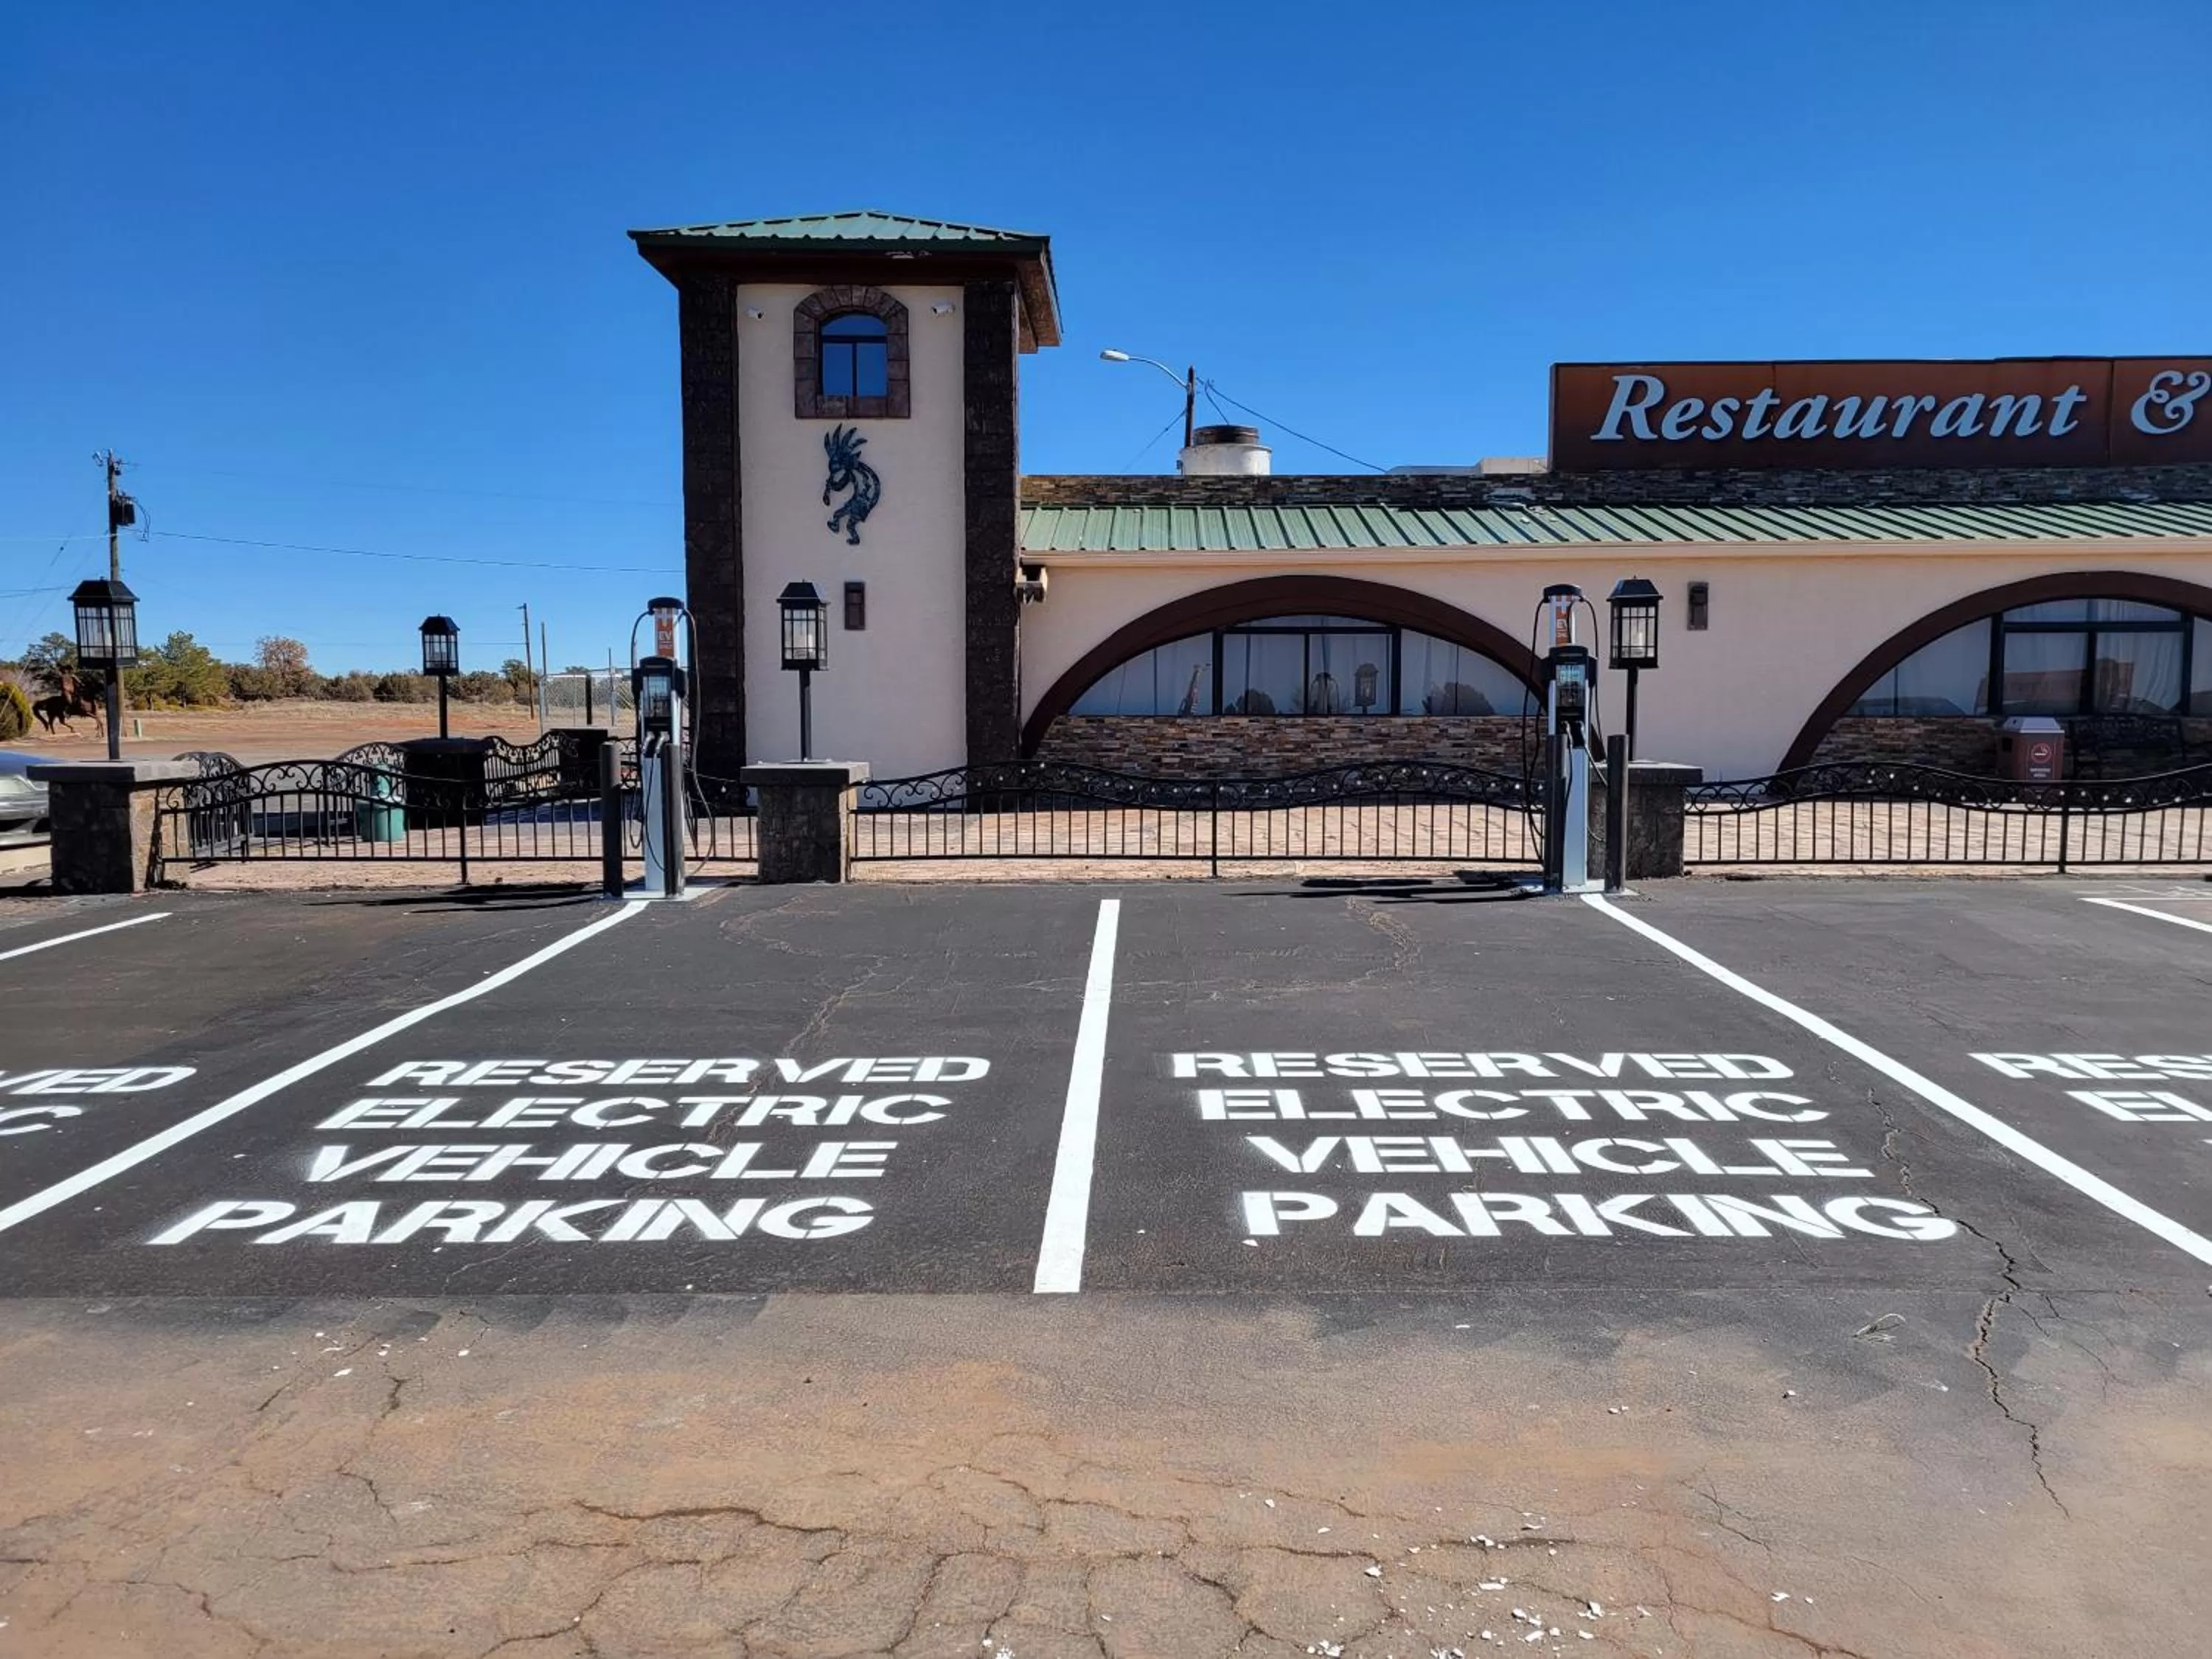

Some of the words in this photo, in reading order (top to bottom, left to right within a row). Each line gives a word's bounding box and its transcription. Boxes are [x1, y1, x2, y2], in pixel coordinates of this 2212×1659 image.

[1590, 375, 2087, 440] Restaurant
[2130, 369, 2211, 434] &
[366, 1056, 991, 1086] RESERVED
[1171, 1051, 1795, 1079] RESERVED
[315, 1093, 952, 1130] ELECTRIC
[1197, 1088, 1830, 1122] ELECTRIC
[307, 1141, 898, 1182] VEHICLE
[1245, 1136, 1876, 1178] VEHICLE
[146, 1196, 874, 1245] PARKING
[1242, 1190, 1959, 1241] PARKING
